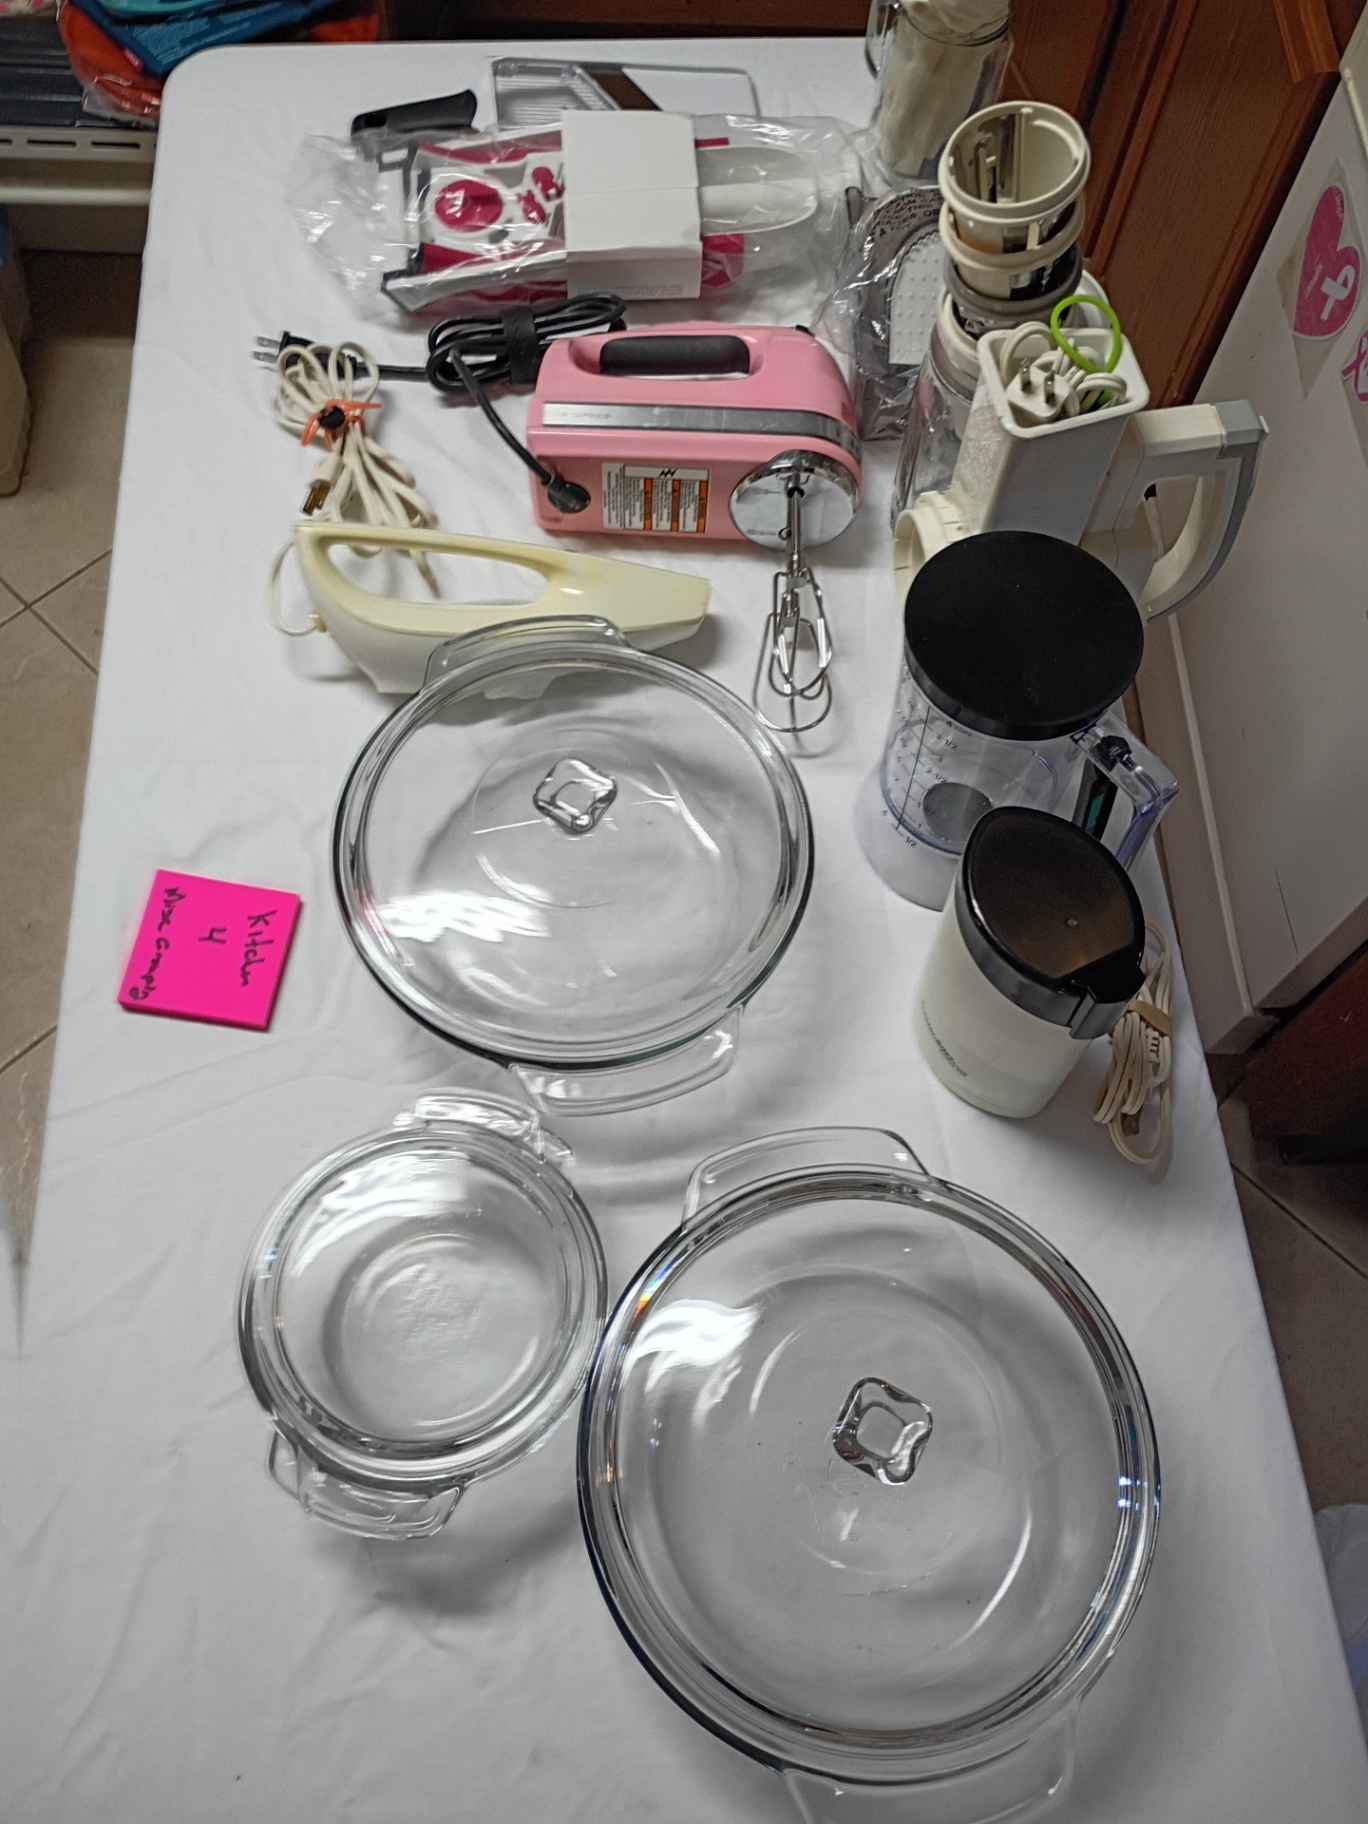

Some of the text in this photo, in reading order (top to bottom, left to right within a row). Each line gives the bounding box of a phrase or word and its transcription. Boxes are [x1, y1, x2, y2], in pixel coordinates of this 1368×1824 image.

[944, 738, 959, 750] 1/2
[905, 836, 917, 847] 1/2
[198, 927, 228, 945] 4
[241, 909, 278, 987] Kitchen
